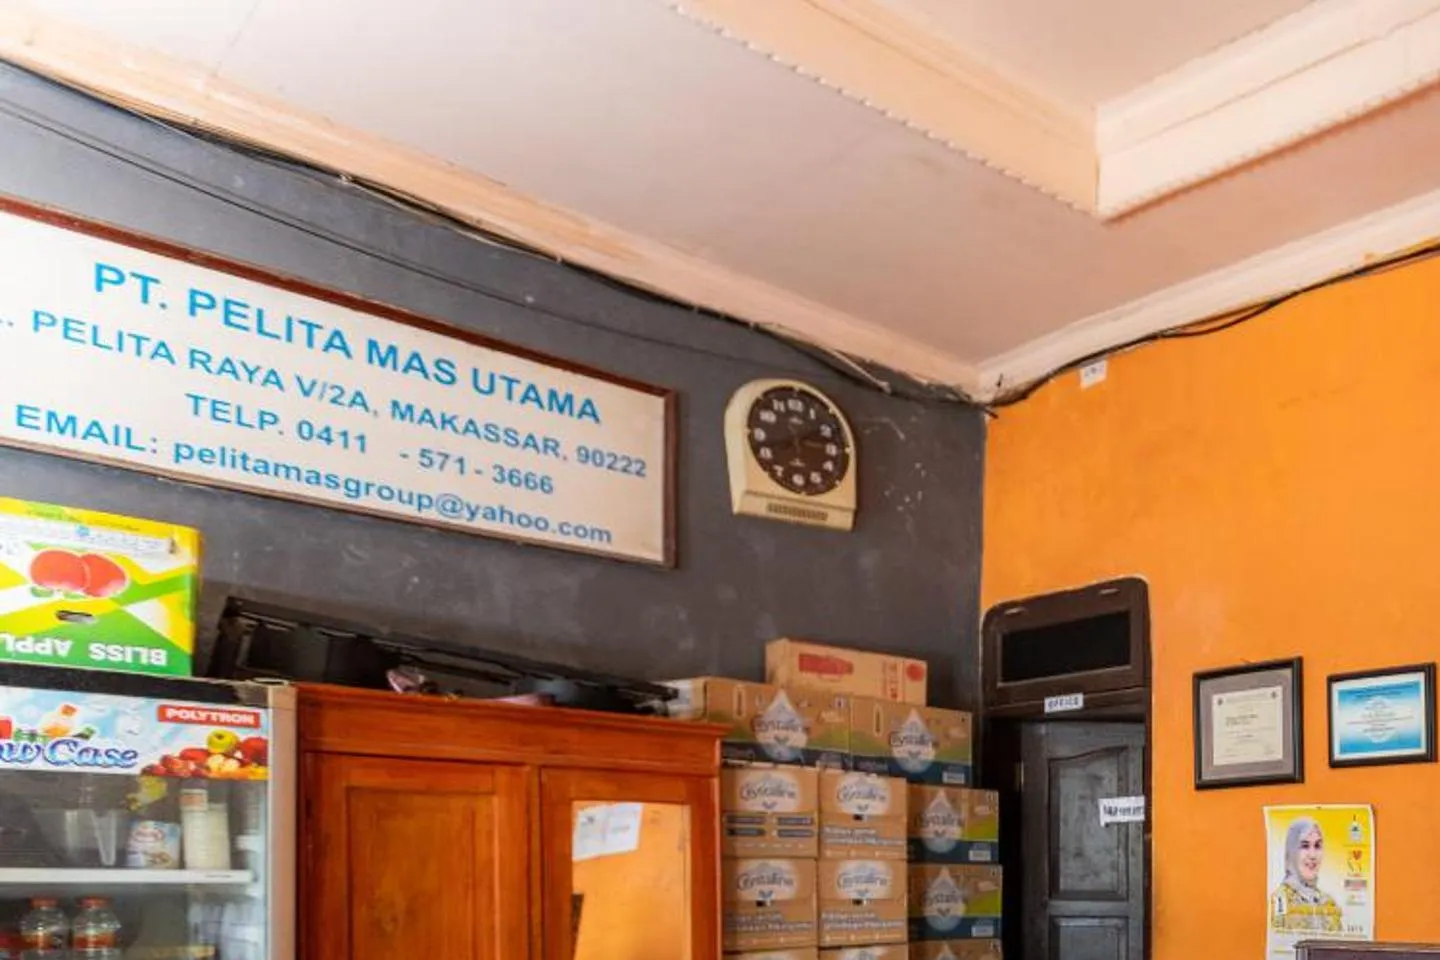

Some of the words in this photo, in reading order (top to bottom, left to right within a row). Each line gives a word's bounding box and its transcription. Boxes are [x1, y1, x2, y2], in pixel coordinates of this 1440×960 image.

[31, 308, 177, 366] PELITA
[187, 347, 286, 394] RAYA
[576, 444, 647, 479] 90222
[94, 262, 167, 311] PT.
[187, 287, 353, 360] PELITA
[365, 337, 457, 387] MAS
[471, 365, 602, 425] UTAMA
[15, 401, 160, 455] EMAIL:
[172, 437, 613, 545] pelitamasgroup@yahoo.com
[184, 391, 285, 436] TELP.
[296, 419, 368, 455] 0411
[418, 446, 467, 479] 571
[491, 463, 556, 496] 3666
[89, 642, 168, 666] BLISS
[165, 707, 255, 726] POLYTRON
